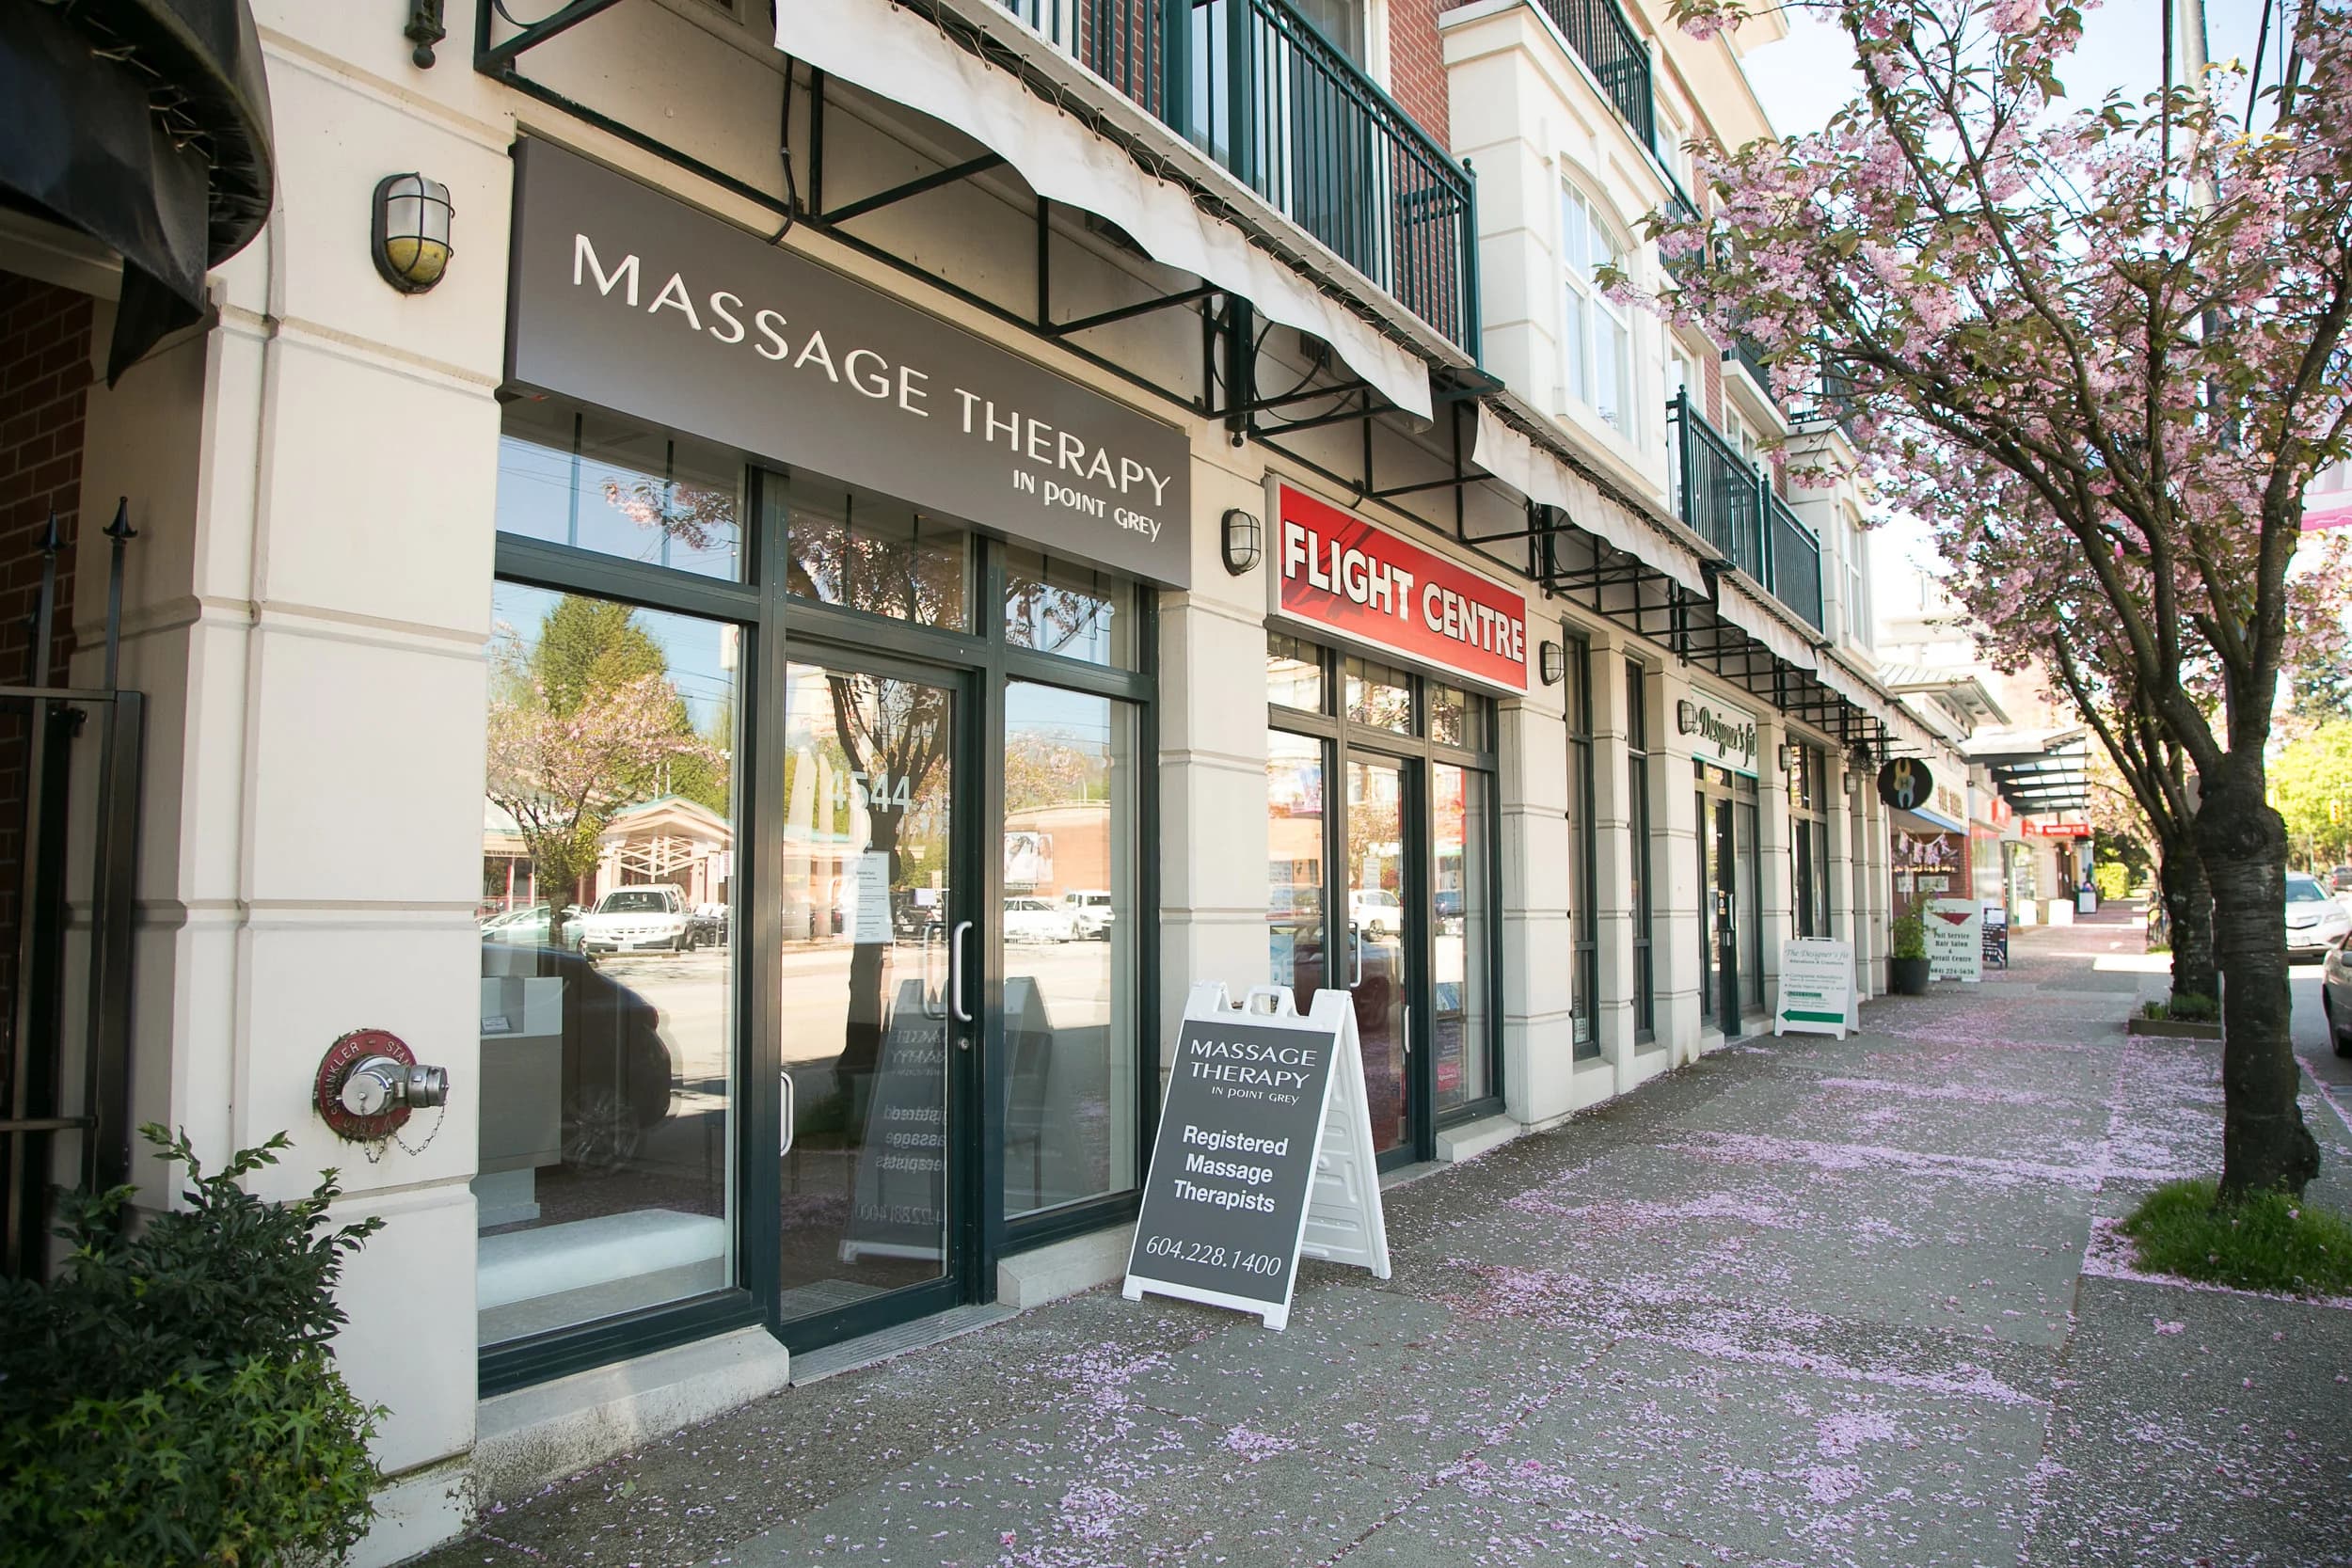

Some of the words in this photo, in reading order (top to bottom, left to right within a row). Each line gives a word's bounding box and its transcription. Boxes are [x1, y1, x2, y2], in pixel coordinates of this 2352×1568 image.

[573, 233, 930, 419] MASSAGE
[954, 388, 1171, 507] THERAPY
[1012, 468, 1035, 495] IN
[1043, 481, 1105, 518] POINT
[1114, 508, 1162, 543] GREY
[1283, 519, 1414, 623] FLIGHT
[1422, 581, 1524, 663] CENTRE
[1699, 706, 1744, 759] Designer's
[826, 769, 913, 815] 4544
[1190, 1038, 1317, 1068] MASSAGE
[325, 1041, 360, 1116] SPRINKLER
[1191, 1061, 1311, 1089] THERAPY
[1212, 1086, 1223, 1095] IN
[1228, 1086, 1263, 1101] POINT
[1269, 1093, 1299, 1106] GREY
[1183, 1125, 1289, 1157] Registered
[1185, 1153, 1273, 1185] Massage
[1174, 1180, 1275, 1213] Therapists
[1146, 1235, 1282, 1277] 604.228.1400
